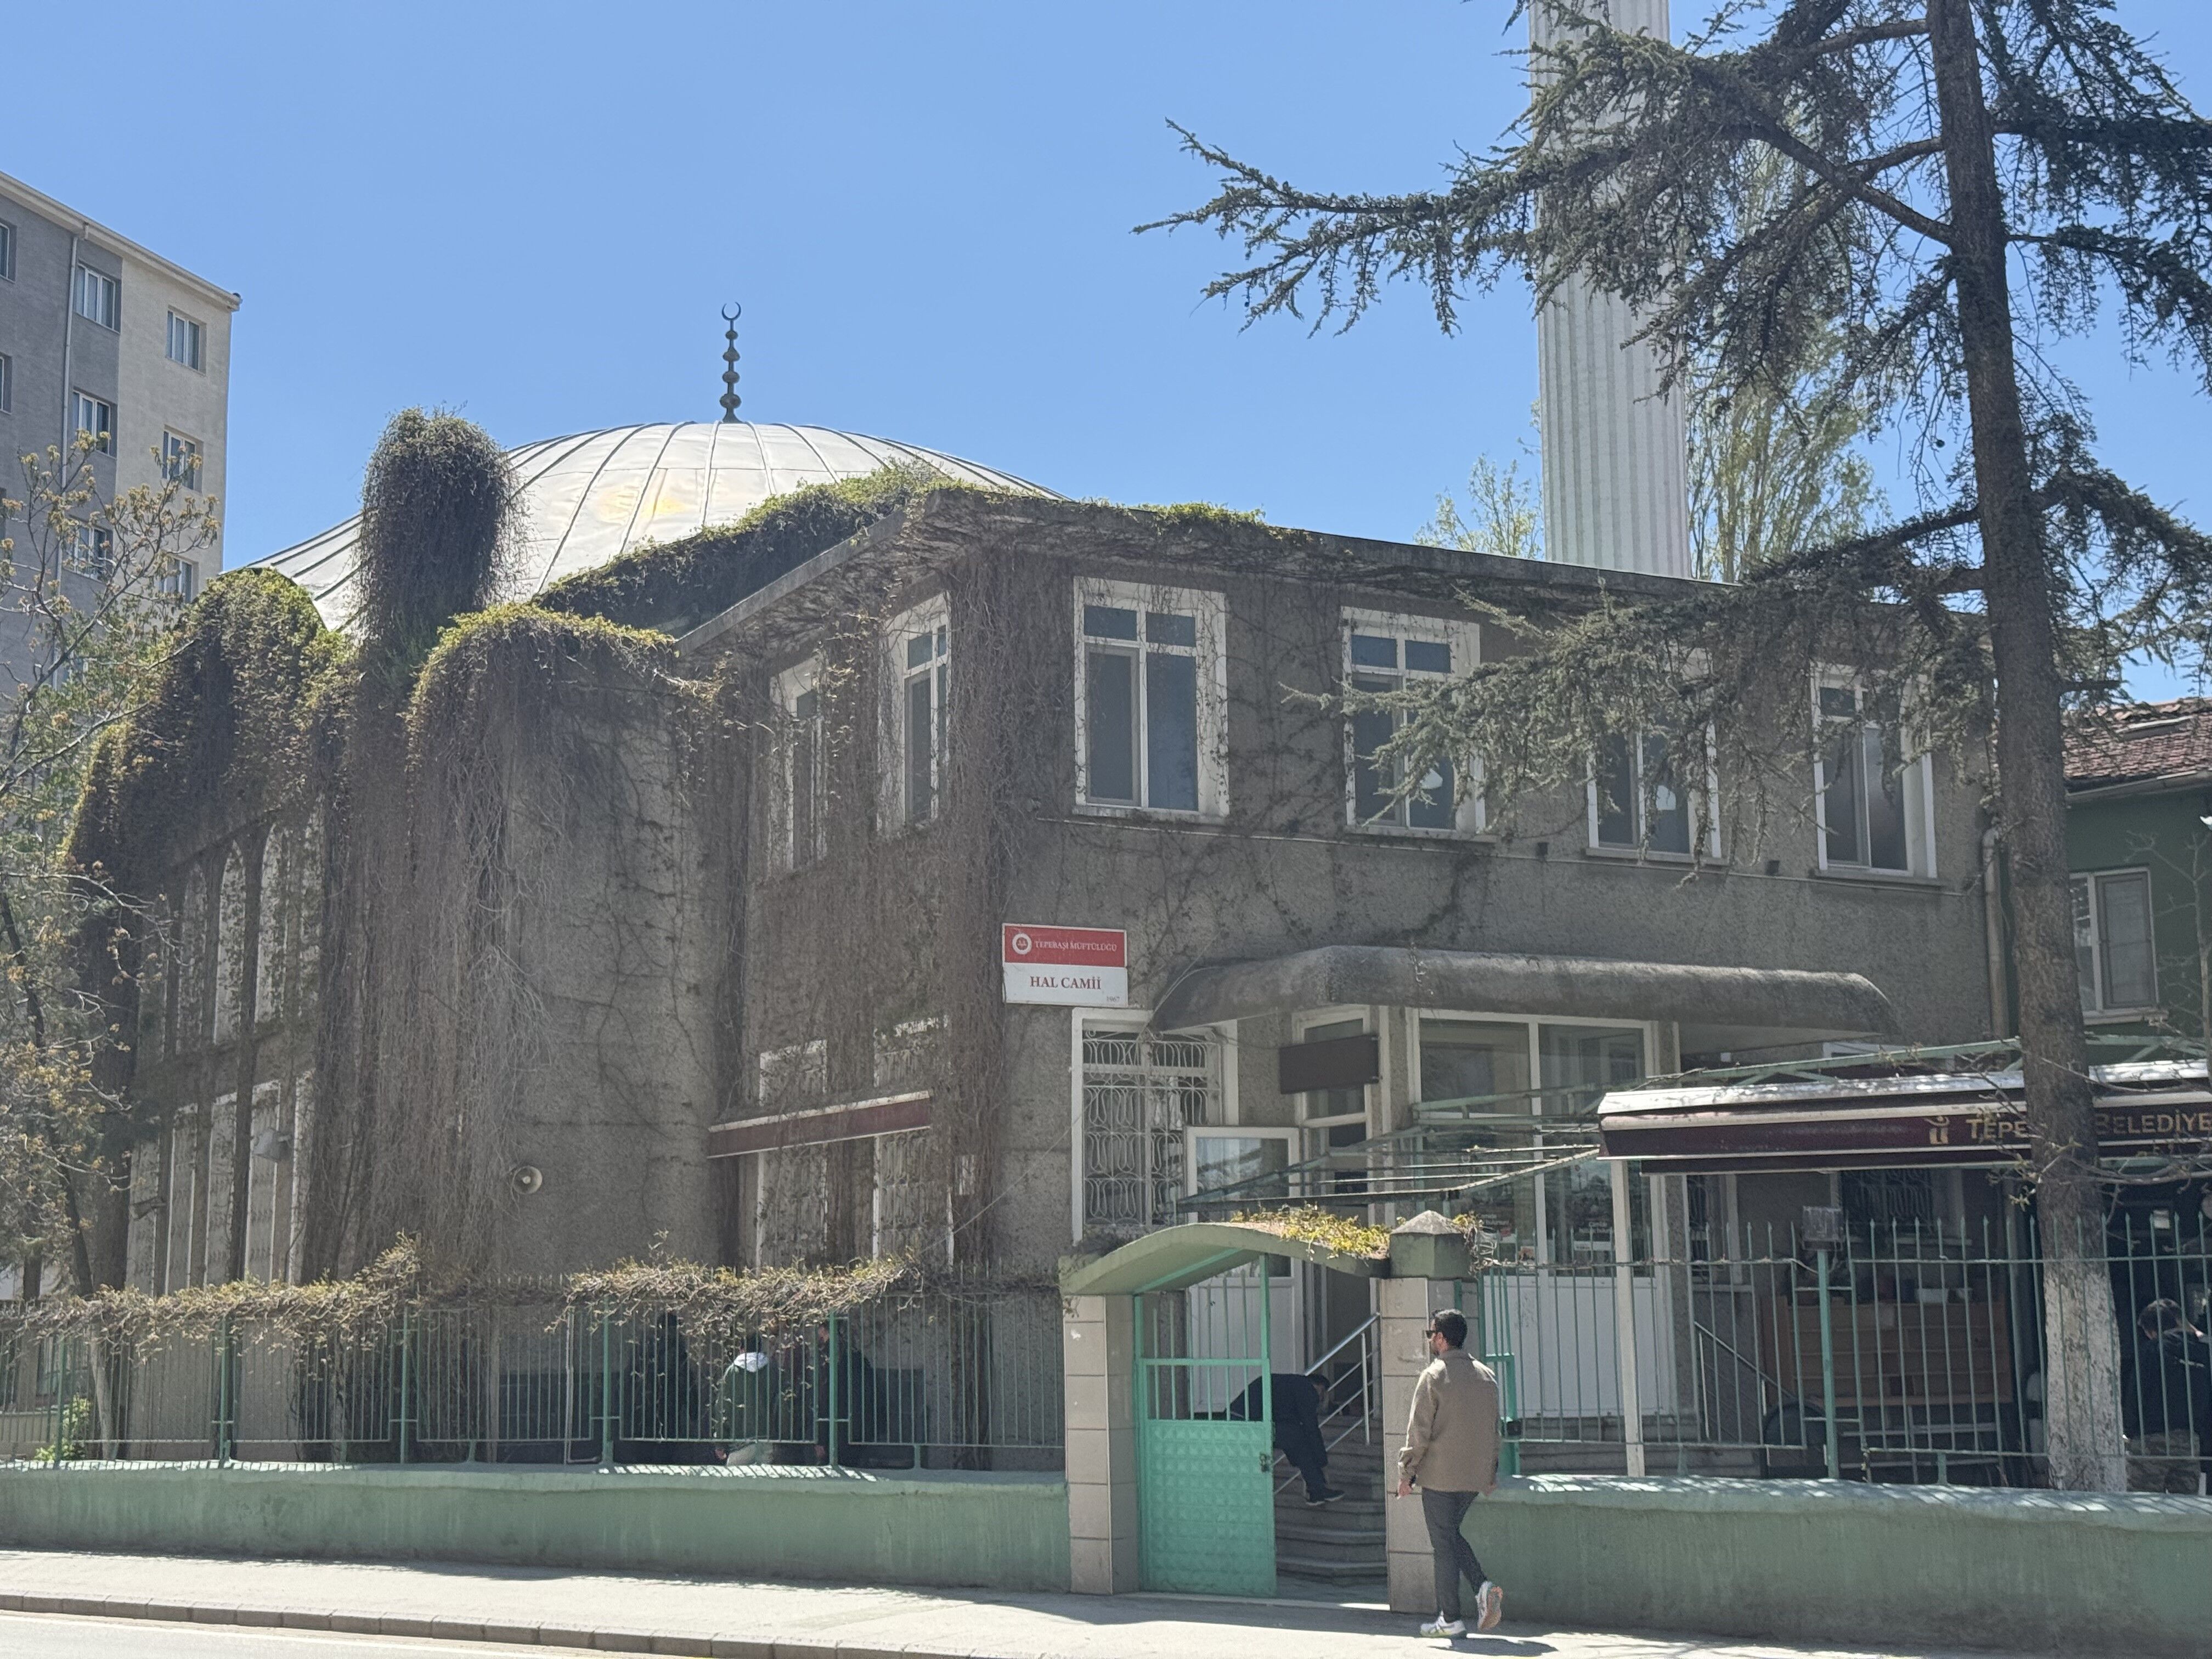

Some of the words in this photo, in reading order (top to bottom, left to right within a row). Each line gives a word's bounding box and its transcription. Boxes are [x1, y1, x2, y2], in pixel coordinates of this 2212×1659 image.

[1030, 976, 1059, 988] HAL
[1061, 977, 1101, 990] CAMİİ
[1966, 1118, 2031, 1139] TEPE
